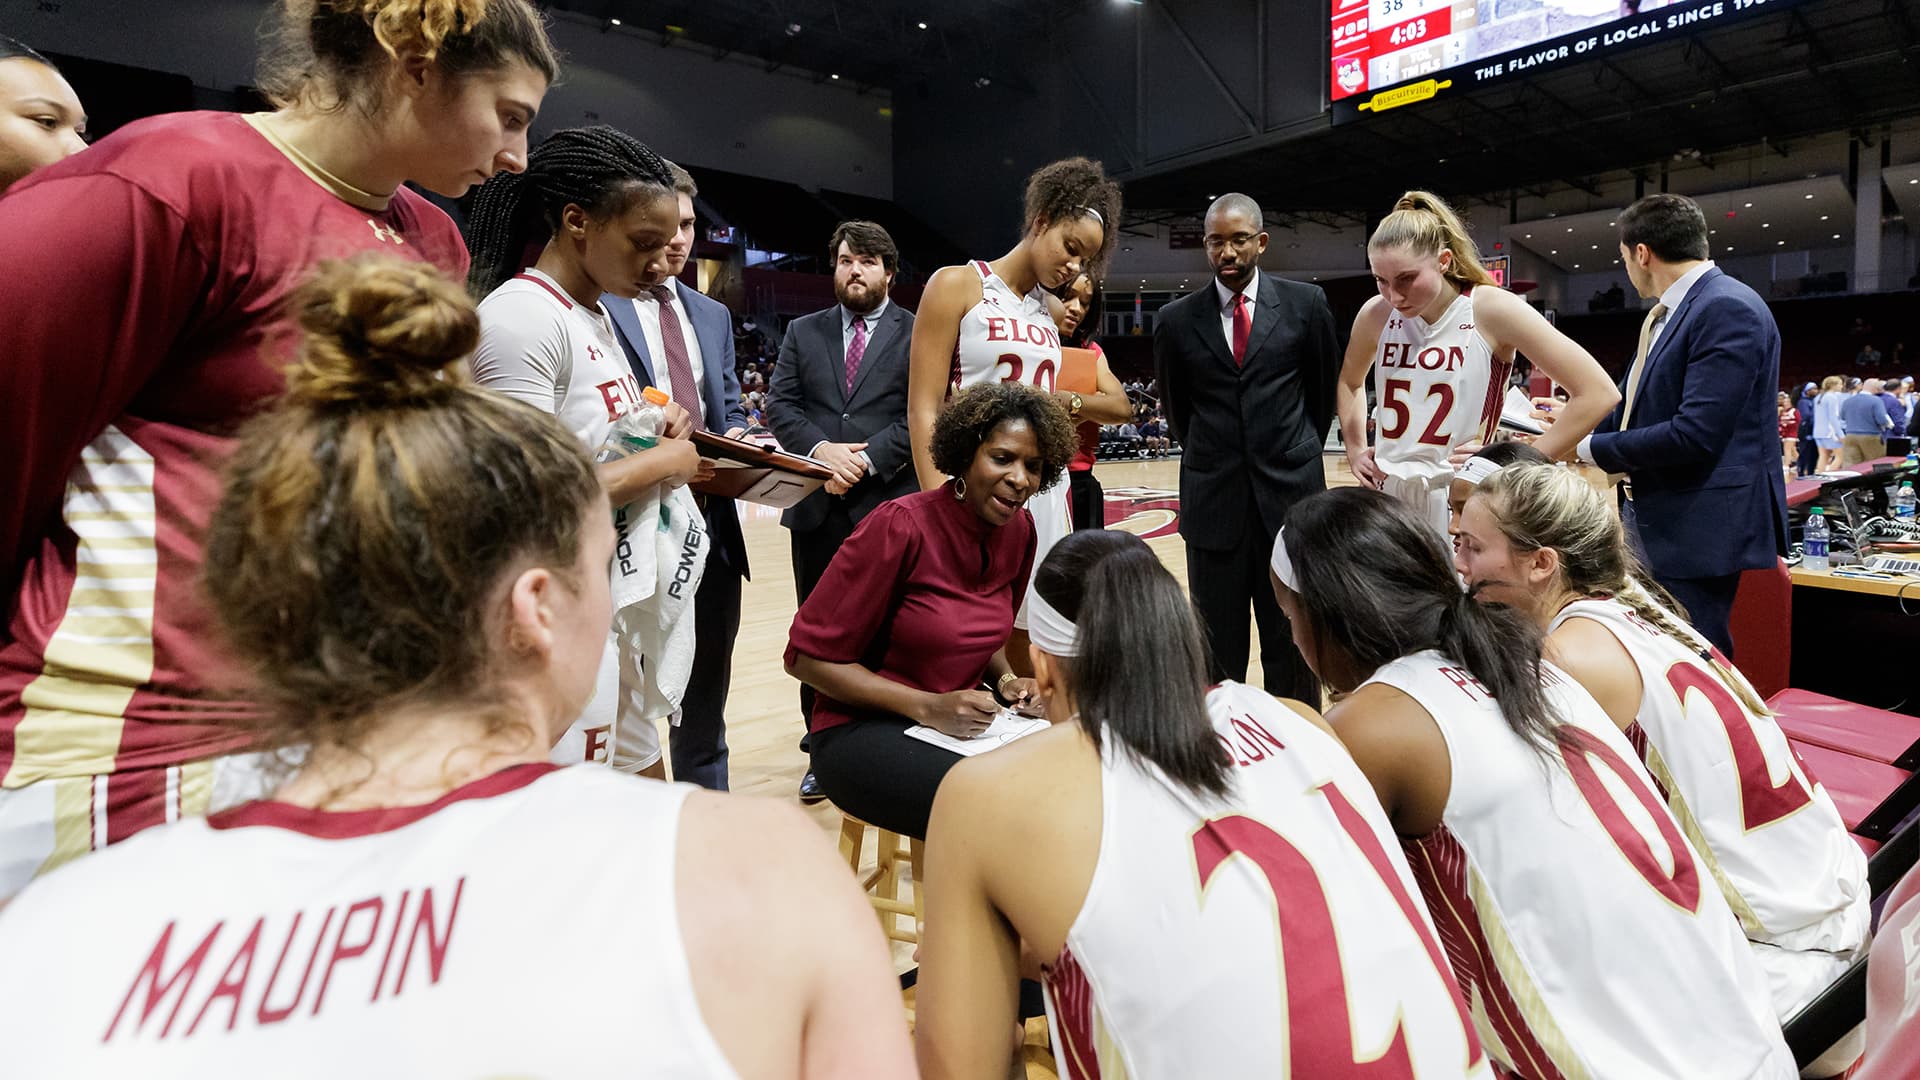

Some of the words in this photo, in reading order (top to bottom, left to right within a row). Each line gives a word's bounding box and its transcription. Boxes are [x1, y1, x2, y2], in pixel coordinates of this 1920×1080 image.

[1389, 18, 1427, 45] 4:03
[1474, 64, 1503, 81] THE
[1508, 46, 1569, 72] FLAVOR
[1574, 37, 1598, 54] OF
[1603, 20, 1661, 46] LOCAL
[1667, 2, 1723, 29] SINCE
[1377, 85, 1431, 105] Biscuitville
[985, 317, 1061, 351] ELON
[1381, 342, 1465, 371] ELON
[1381, 378, 1455, 446] 52
[1554, 723, 1702, 915] 0
[102, 875, 466, 1043] MAUPIN
[1186, 776, 1484, 1080] 21
